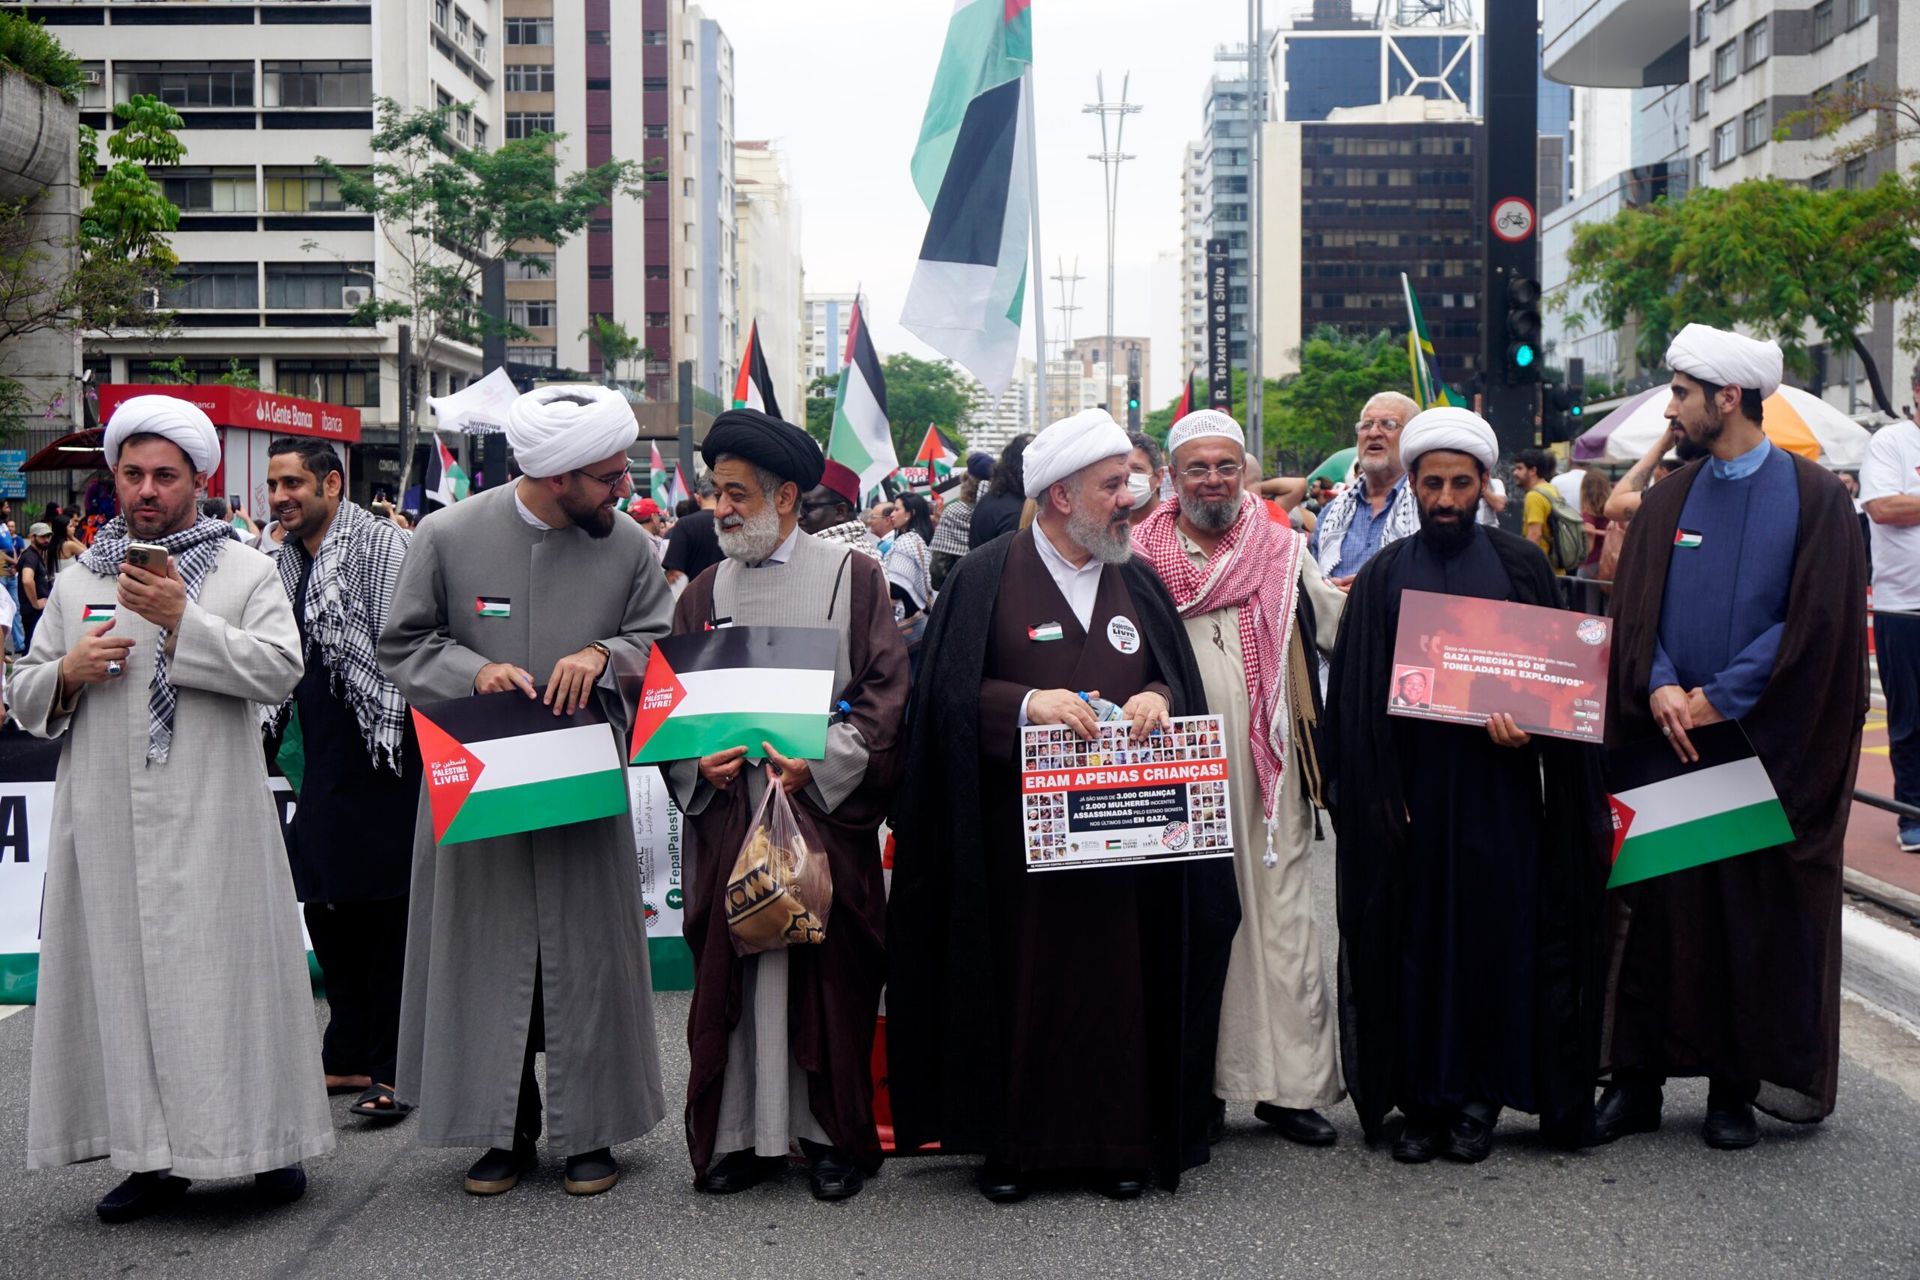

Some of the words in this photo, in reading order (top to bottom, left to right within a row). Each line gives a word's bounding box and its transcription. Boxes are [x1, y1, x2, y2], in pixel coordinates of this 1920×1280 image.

[1213, 267, 1226, 301] Silva
[1214, 305, 1226, 322] da
[1214, 327, 1227, 382] Teixeira
[1215, 386, 1227, 400] R.
[264, 401, 271, 422] A
[271, 401, 291, 425] Gente
[322, 410, 342, 432] ibanca
[1442, 661, 1501, 675] TONELADAS
[1503, 668, 1517, 677] DE
[1443, 652, 1470, 662] GAZA
[1472, 655, 1514, 667] PRECISA
[1517, 658, 1530, 668] SÓ
[1533, 662, 1546, 671] DE
[643, 699, 673, 710] LIVRE!
[644, 692, 673, 703] PALESTINA
[432, 765, 468, 777] PALESTINA
[1025, 774, 1070, 789] ERAM
[1075, 769, 1140, 786] APENAS
[1143, 763, 1223, 781] CRIANÇAS!
[434, 773, 469, 785] LIVRE!
[1116, 792, 1137, 800] 3.000
[1138, 789, 1176, 798] CRIANÇAS
[1085, 802, 1107, 810] 2.000
[1108, 800, 1150, 809] MULHERES
[1073, 809, 1133, 820] ASSASSINADAS
[1133, 816, 1145, 824] EM
[1146, 814, 1169, 822] GAZA.
[666, 797, 683, 885] FepalPalestin
